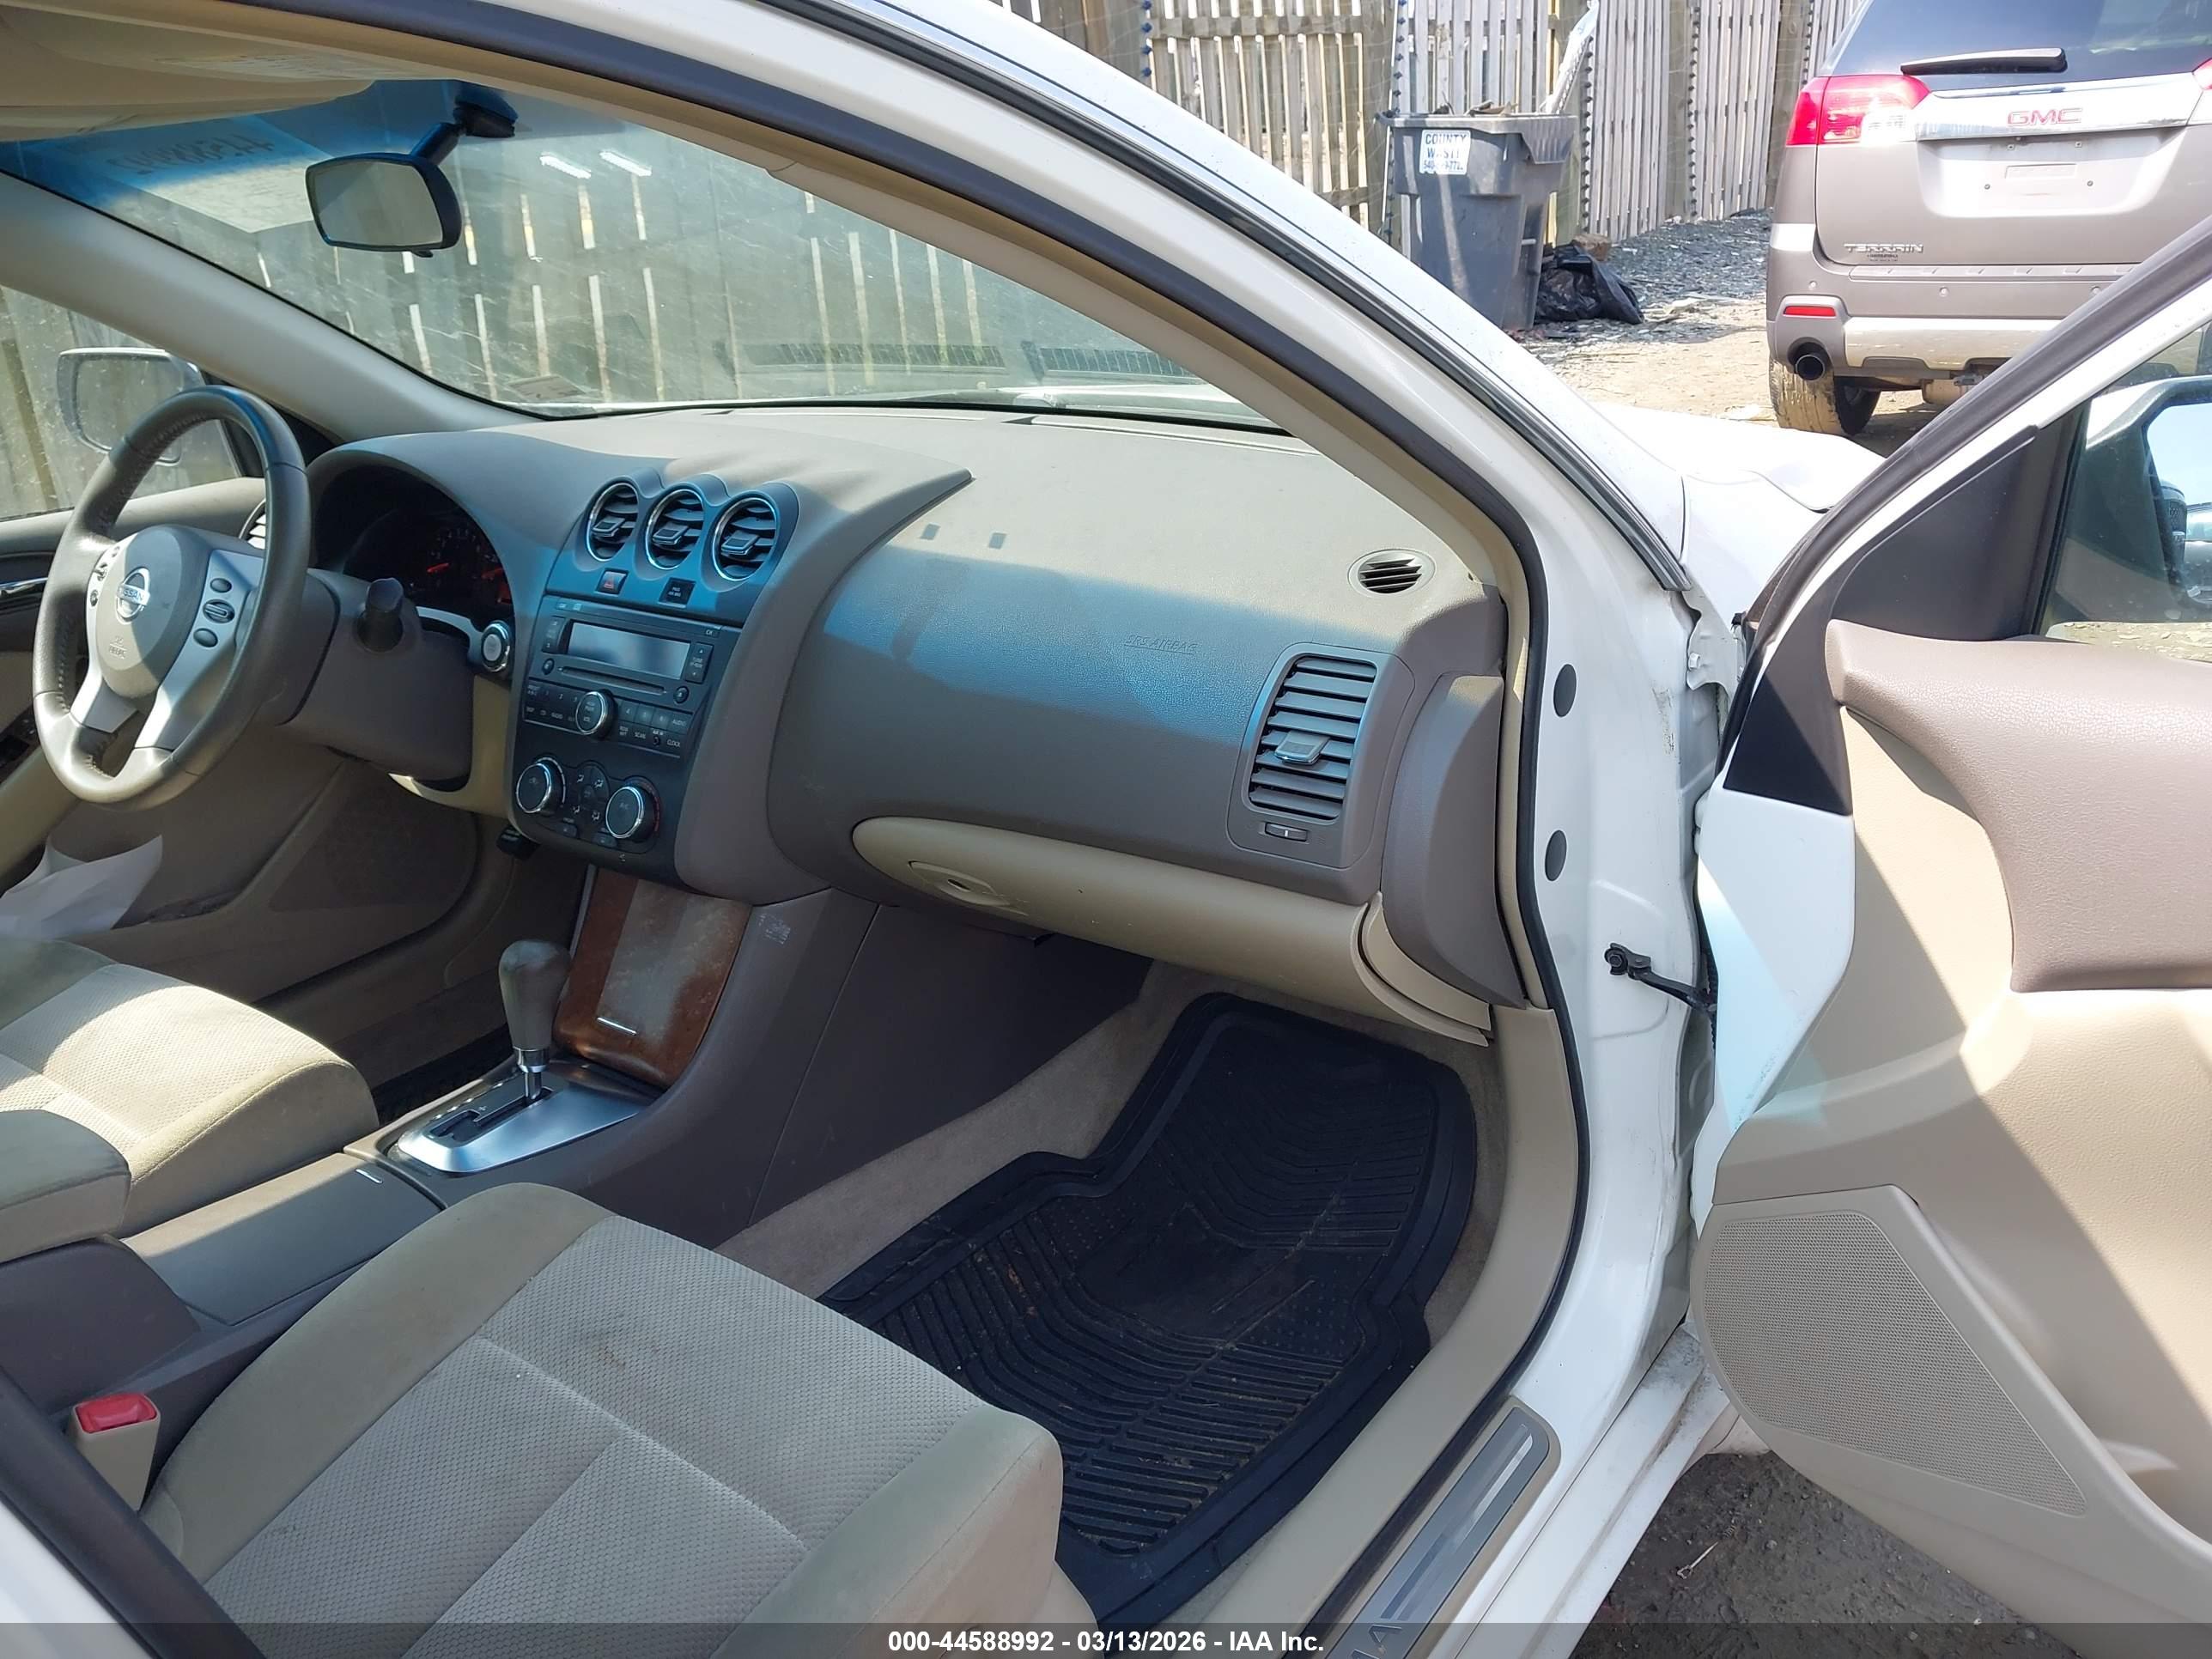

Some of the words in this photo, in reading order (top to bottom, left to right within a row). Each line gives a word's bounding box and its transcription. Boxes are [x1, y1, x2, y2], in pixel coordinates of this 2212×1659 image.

[2007, 108, 2082, 126] GMC
[1425, 133, 1467, 144] COUNTY
[1844, 243, 1923, 252] TERRAIN
